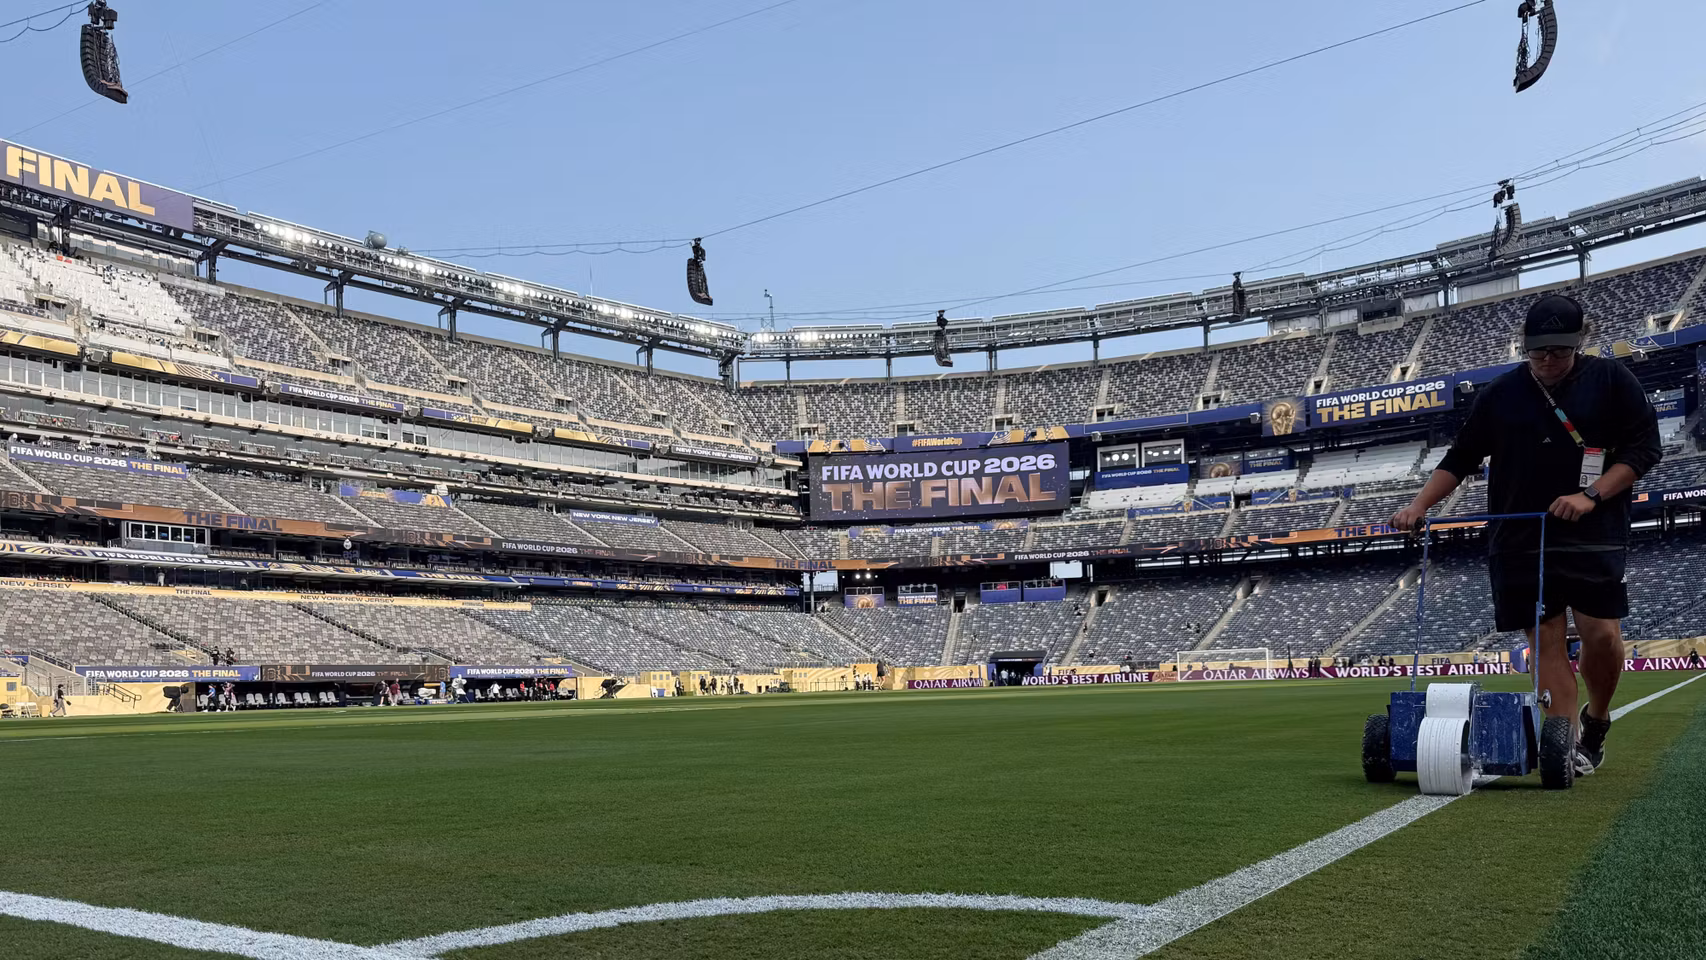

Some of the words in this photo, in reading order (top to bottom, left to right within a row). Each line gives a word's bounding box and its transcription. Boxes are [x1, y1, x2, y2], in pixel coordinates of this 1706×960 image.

[6, 145, 156, 216] FINAL
[1316, 397, 1339, 408] FIFA
[1340, 391, 1381, 404] WORLD
[1381, 387, 1404, 398] CUP
[1405, 380, 1446, 395] 2026
[1316, 402, 1366, 423] THE
[1370, 391, 1447, 417] FINAL
[10, 446, 34, 457] FIFA
[34, 448, 72, 461] WORLD
[73, 453, 93, 464] CUP
[93, 456, 128, 468] 2026
[130, 461, 153, 471] THE
[153, 464, 186, 475] FINAL
[821, 465, 864, 481] FIFA
[865, 460, 938, 480] WORLD
[939, 458, 981, 476] CUP
[983, 453, 1057, 474] 2026
[821, 480, 912, 512] THE
[920, 472, 1057, 508] FINAL
[1663, 492, 1683, 501] FIFA
[1684, 489, 1706, 498] WOR
[183, 511, 223, 527] THE
[226, 515, 283, 532] FINAL
[1334, 526, 1367, 538] THE
[1370, 523, 1398, 534] FIN
[517, 543, 542, 551] WORLD
[555, 546, 578, 554] 2026
[1029, 552, 1053, 560] WORLD
[1053, 551, 1066, 559] CUP
[1066, 550, 1090, 558] 2026
[95, 551, 127, 559] FIFA
[127, 553, 175, 562] WORLD
[175, 556, 201, 564] CUP
[775, 559, 796, 569] THE
[797, 559, 837, 569] FINAL
[0, 579, 26, 587] NEW
[29, 581, 72, 589] JERSEY
[85, 670, 105, 678] FIFA
[106, 670, 140, 678] WORLD
[140, 670, 158, 678] CUP
[159, 669, 190, 678] 2026
[192, 669, 212, 678] THE
[212, 669, 241, 677] FINAL
[1202, 668, 1247, 681] QATAR
[1251, 667, 1310, 680] AIRWAYS
[1336, 665, 1402, 679] WORLD'S
[1406, 664, 1444, 677] BEST
[913, 679, 948, 690] QATAR
[951, 677, 985, 688] AIRWAY
[1021, 673, 1069, 686] WORLD'S
[1072, 673, 1099, 685] BEST
[1102, 672, 1150, 684] AIRLINE
